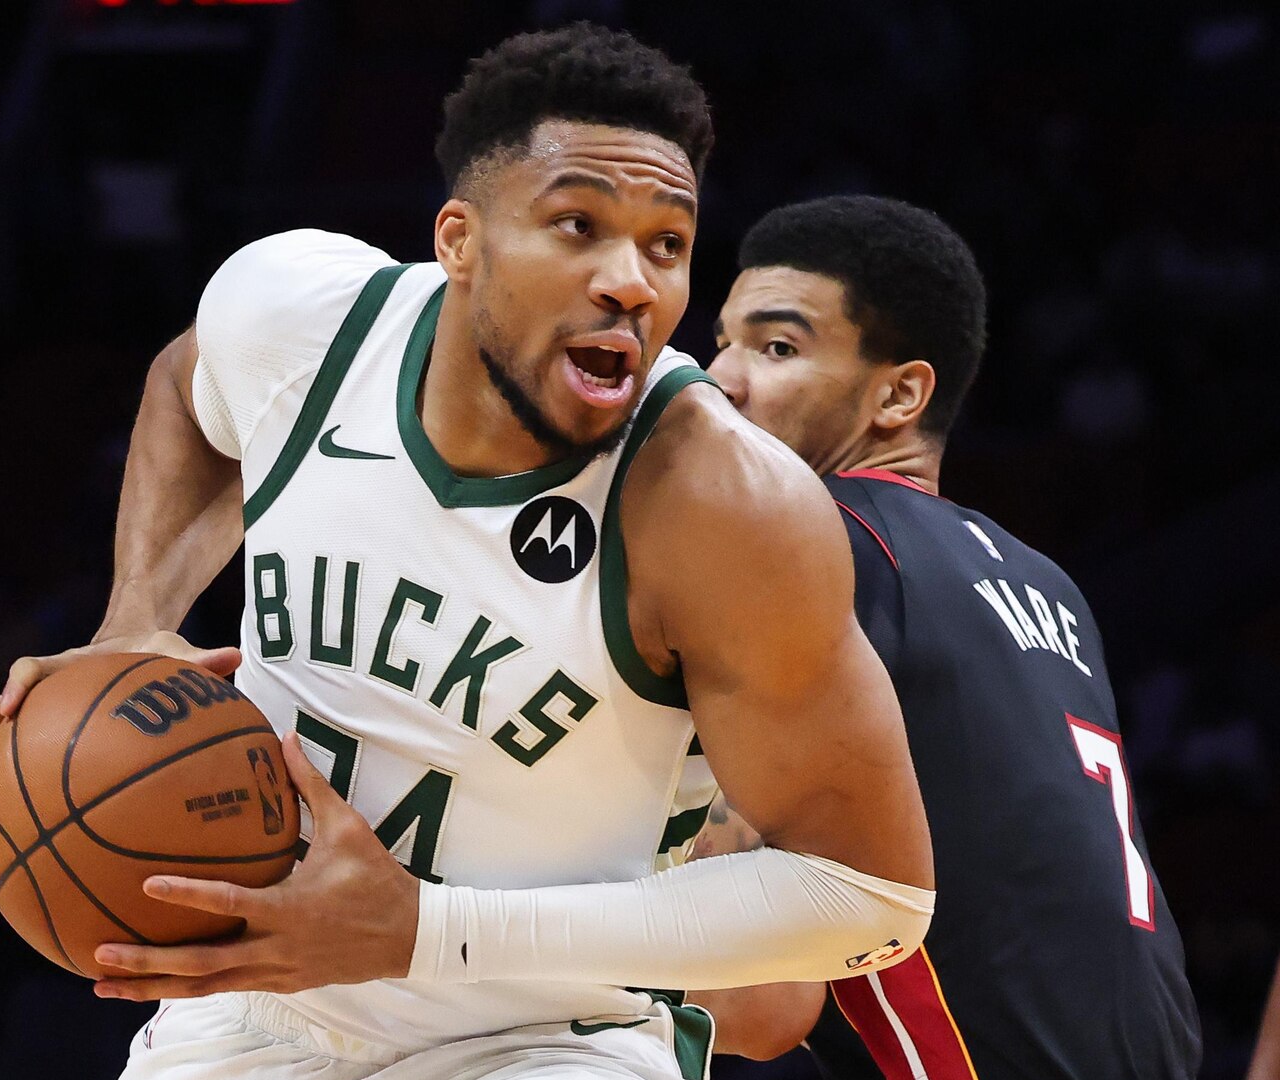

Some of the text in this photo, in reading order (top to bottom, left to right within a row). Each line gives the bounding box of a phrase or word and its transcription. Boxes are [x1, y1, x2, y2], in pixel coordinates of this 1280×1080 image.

[253, 550, 603, 768] BUCKS
[973, 578, 1093, 678] WARE
[1064, 711, 1156, 933] 7
